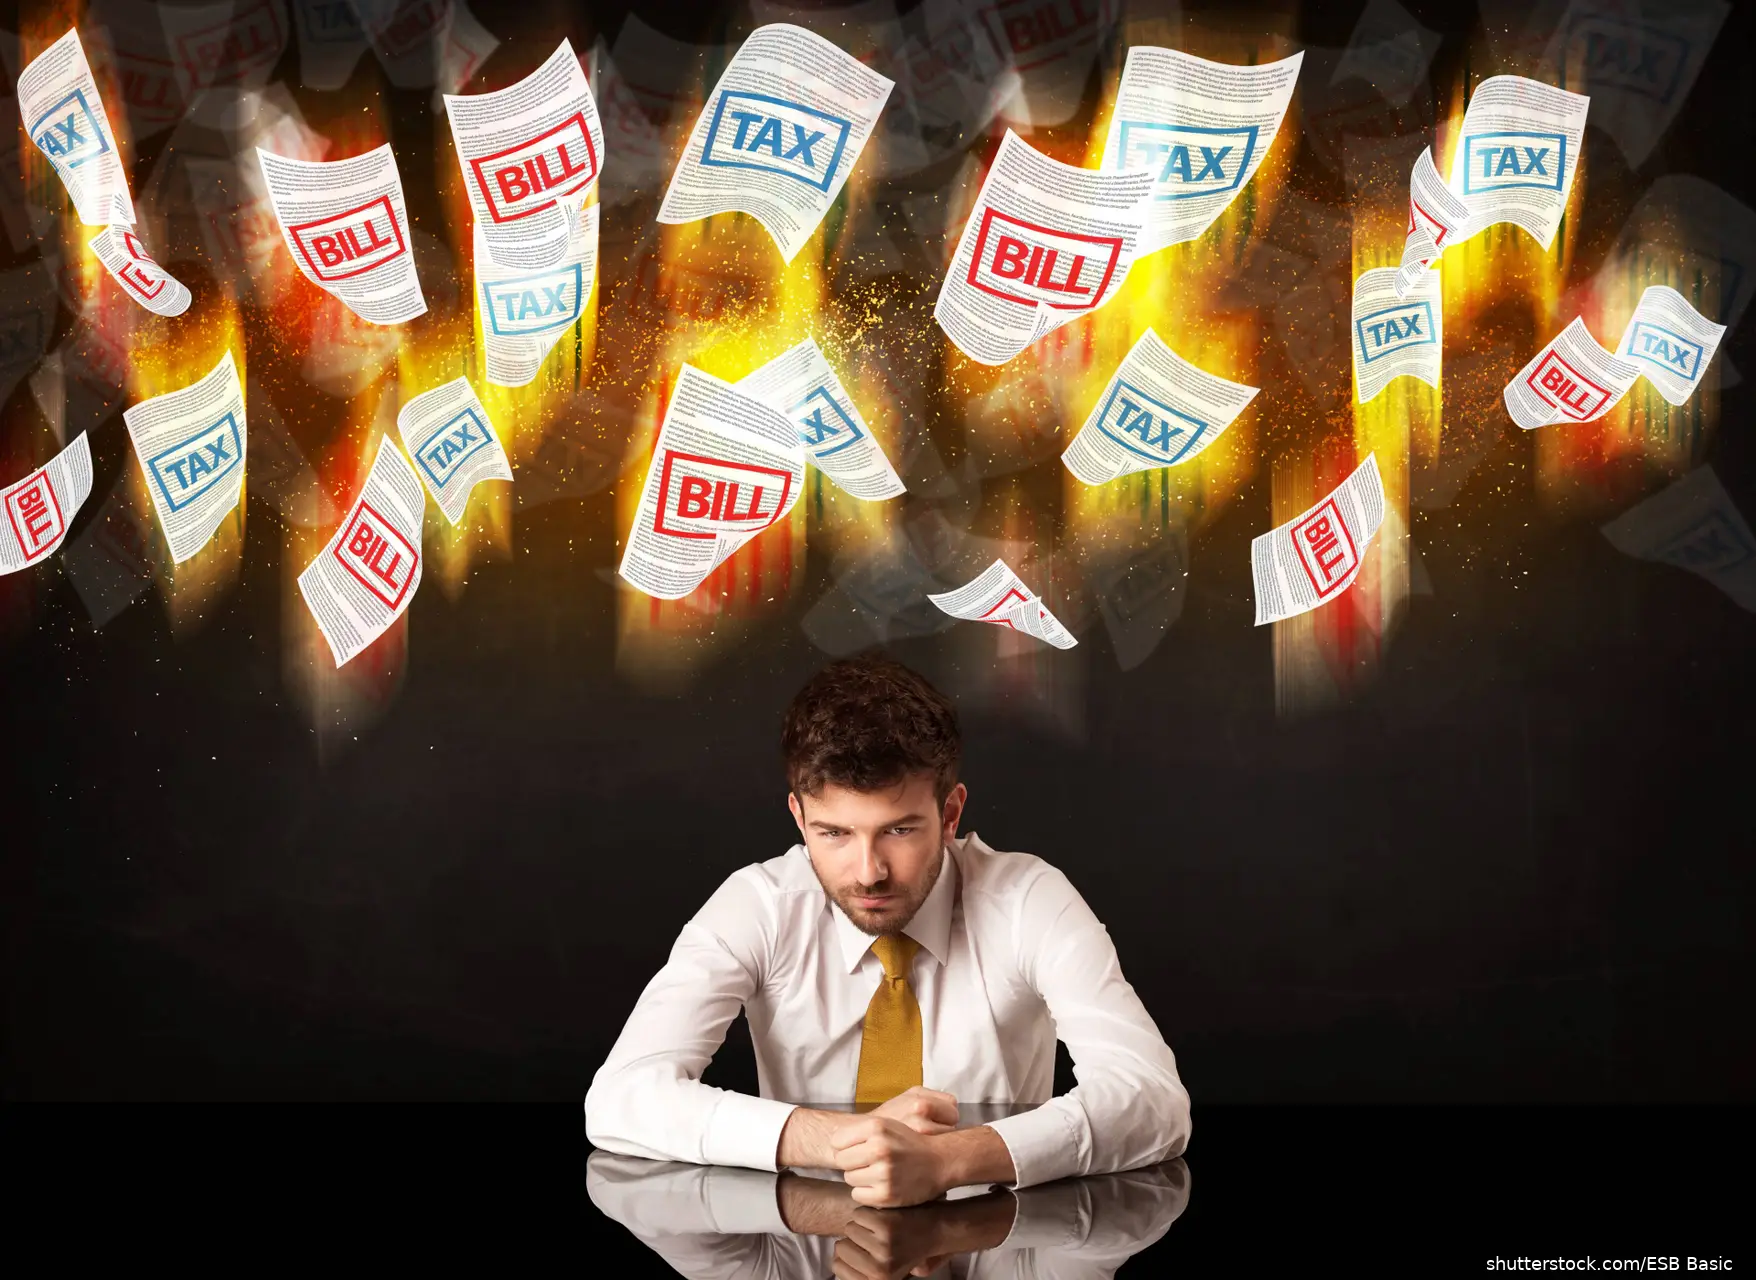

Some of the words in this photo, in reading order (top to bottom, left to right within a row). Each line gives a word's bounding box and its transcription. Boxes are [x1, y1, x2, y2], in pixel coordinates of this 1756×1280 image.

[731, 112, 825, 168] TAX
[1136, 143, 1233, 182] TAX
[1476, 147, 1549, 177] TAX
[495, 144, 586, 203] BILL
[312, 220, 392, 268] BILL
[992, 236, 1091, 295] BILL
[497, 283, 567, 321] TAX
[1367, 313, 1423, 347] TAX
[1641, 332, 1691, 369] TAX
[1540, 366, 1590, 413] BILL
[427, 423, 478, 470] TAX
[1115, 399, 1185, 452] TAX
[165, 435, 231, 489] TAX
[18, 485, 53, 546] BILL
[677, 476, 769, 521] BILL
[349, 521, 401, 590] BILL
[1305, 515, 1346, 582] BILL
